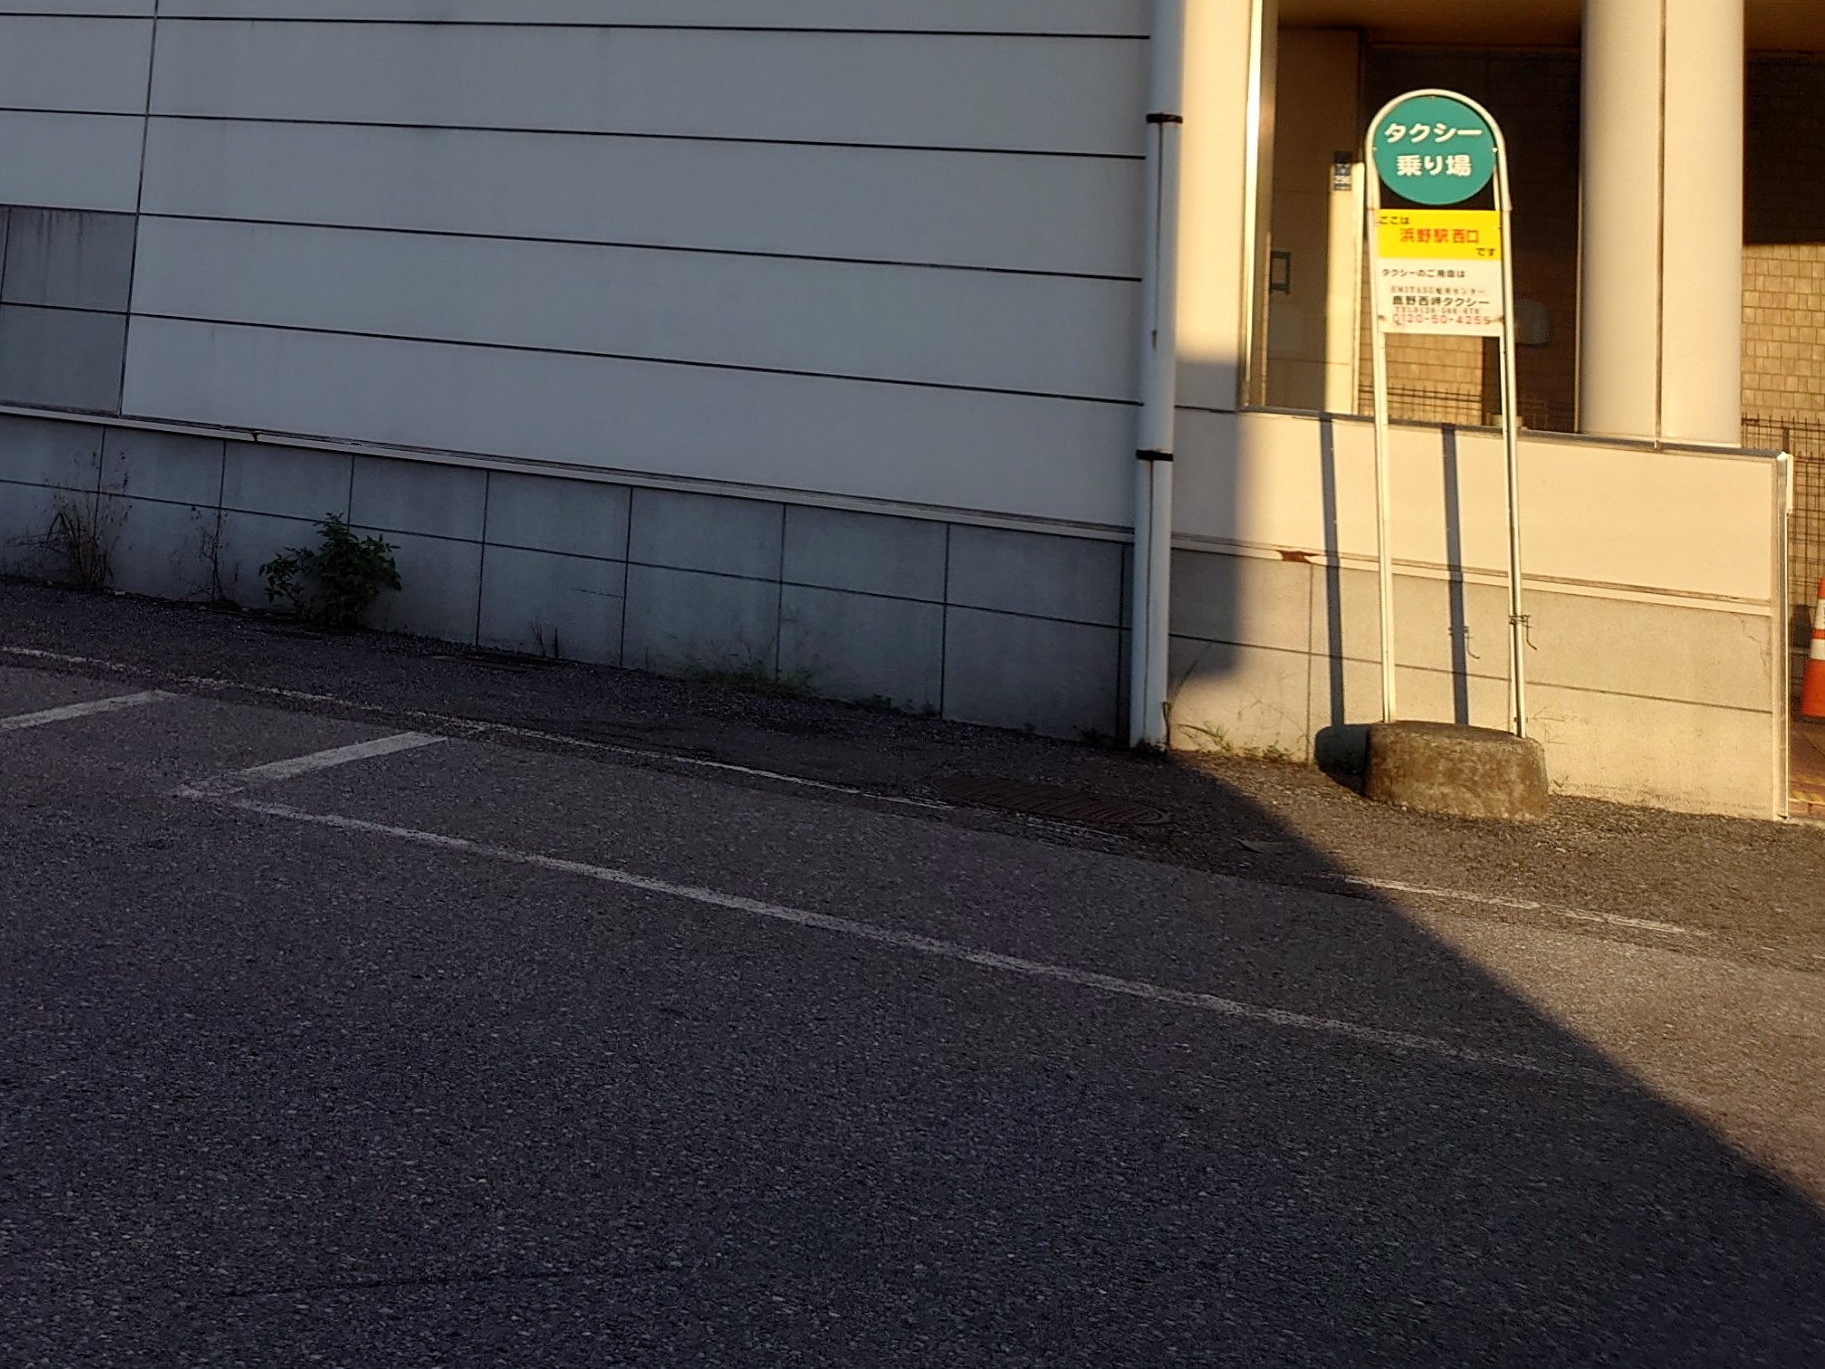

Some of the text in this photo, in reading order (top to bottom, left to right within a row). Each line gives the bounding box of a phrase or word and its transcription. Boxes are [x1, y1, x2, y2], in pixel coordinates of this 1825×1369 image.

[1384, 122, 1483, 143] タクシー
[1396, 154, 1472, 176] 乗り場
[1379, 216, 1410, 225] ここは
[1476, 247, 1496, 257] です
